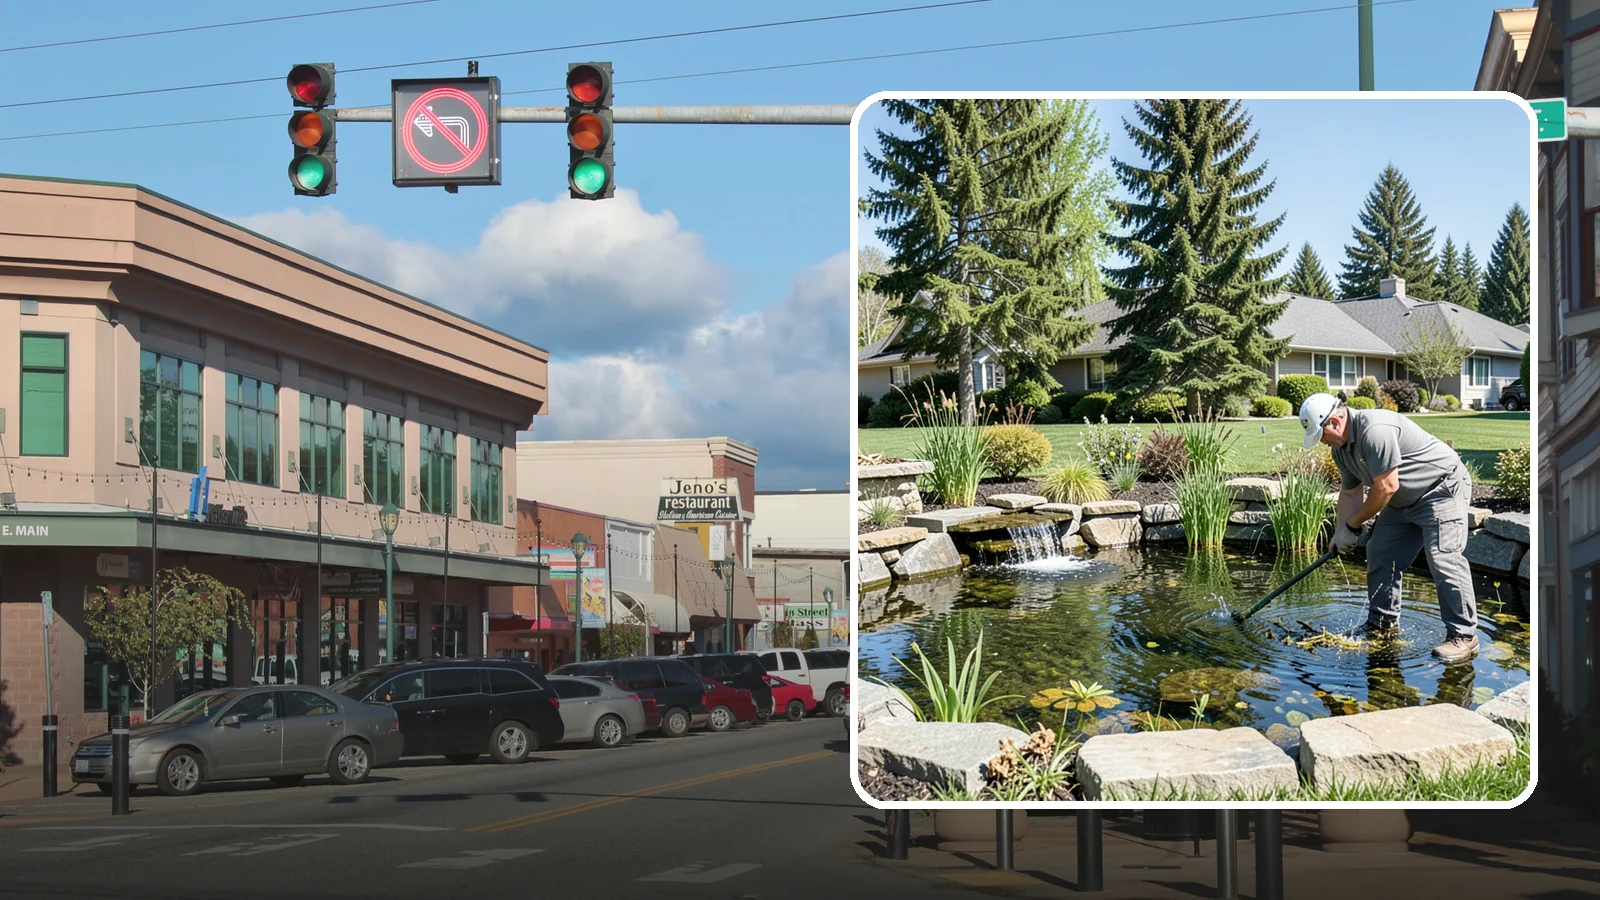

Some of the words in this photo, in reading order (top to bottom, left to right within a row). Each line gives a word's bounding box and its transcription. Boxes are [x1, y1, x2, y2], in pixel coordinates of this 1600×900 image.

[669, 480, 727, 494] Jeno's
[665, 496, 731, 509] restaurant
[2, 525, 13, 536] E.
[15, 525, 49, 536] MAIN
[797, 607, 828, 616] Street
